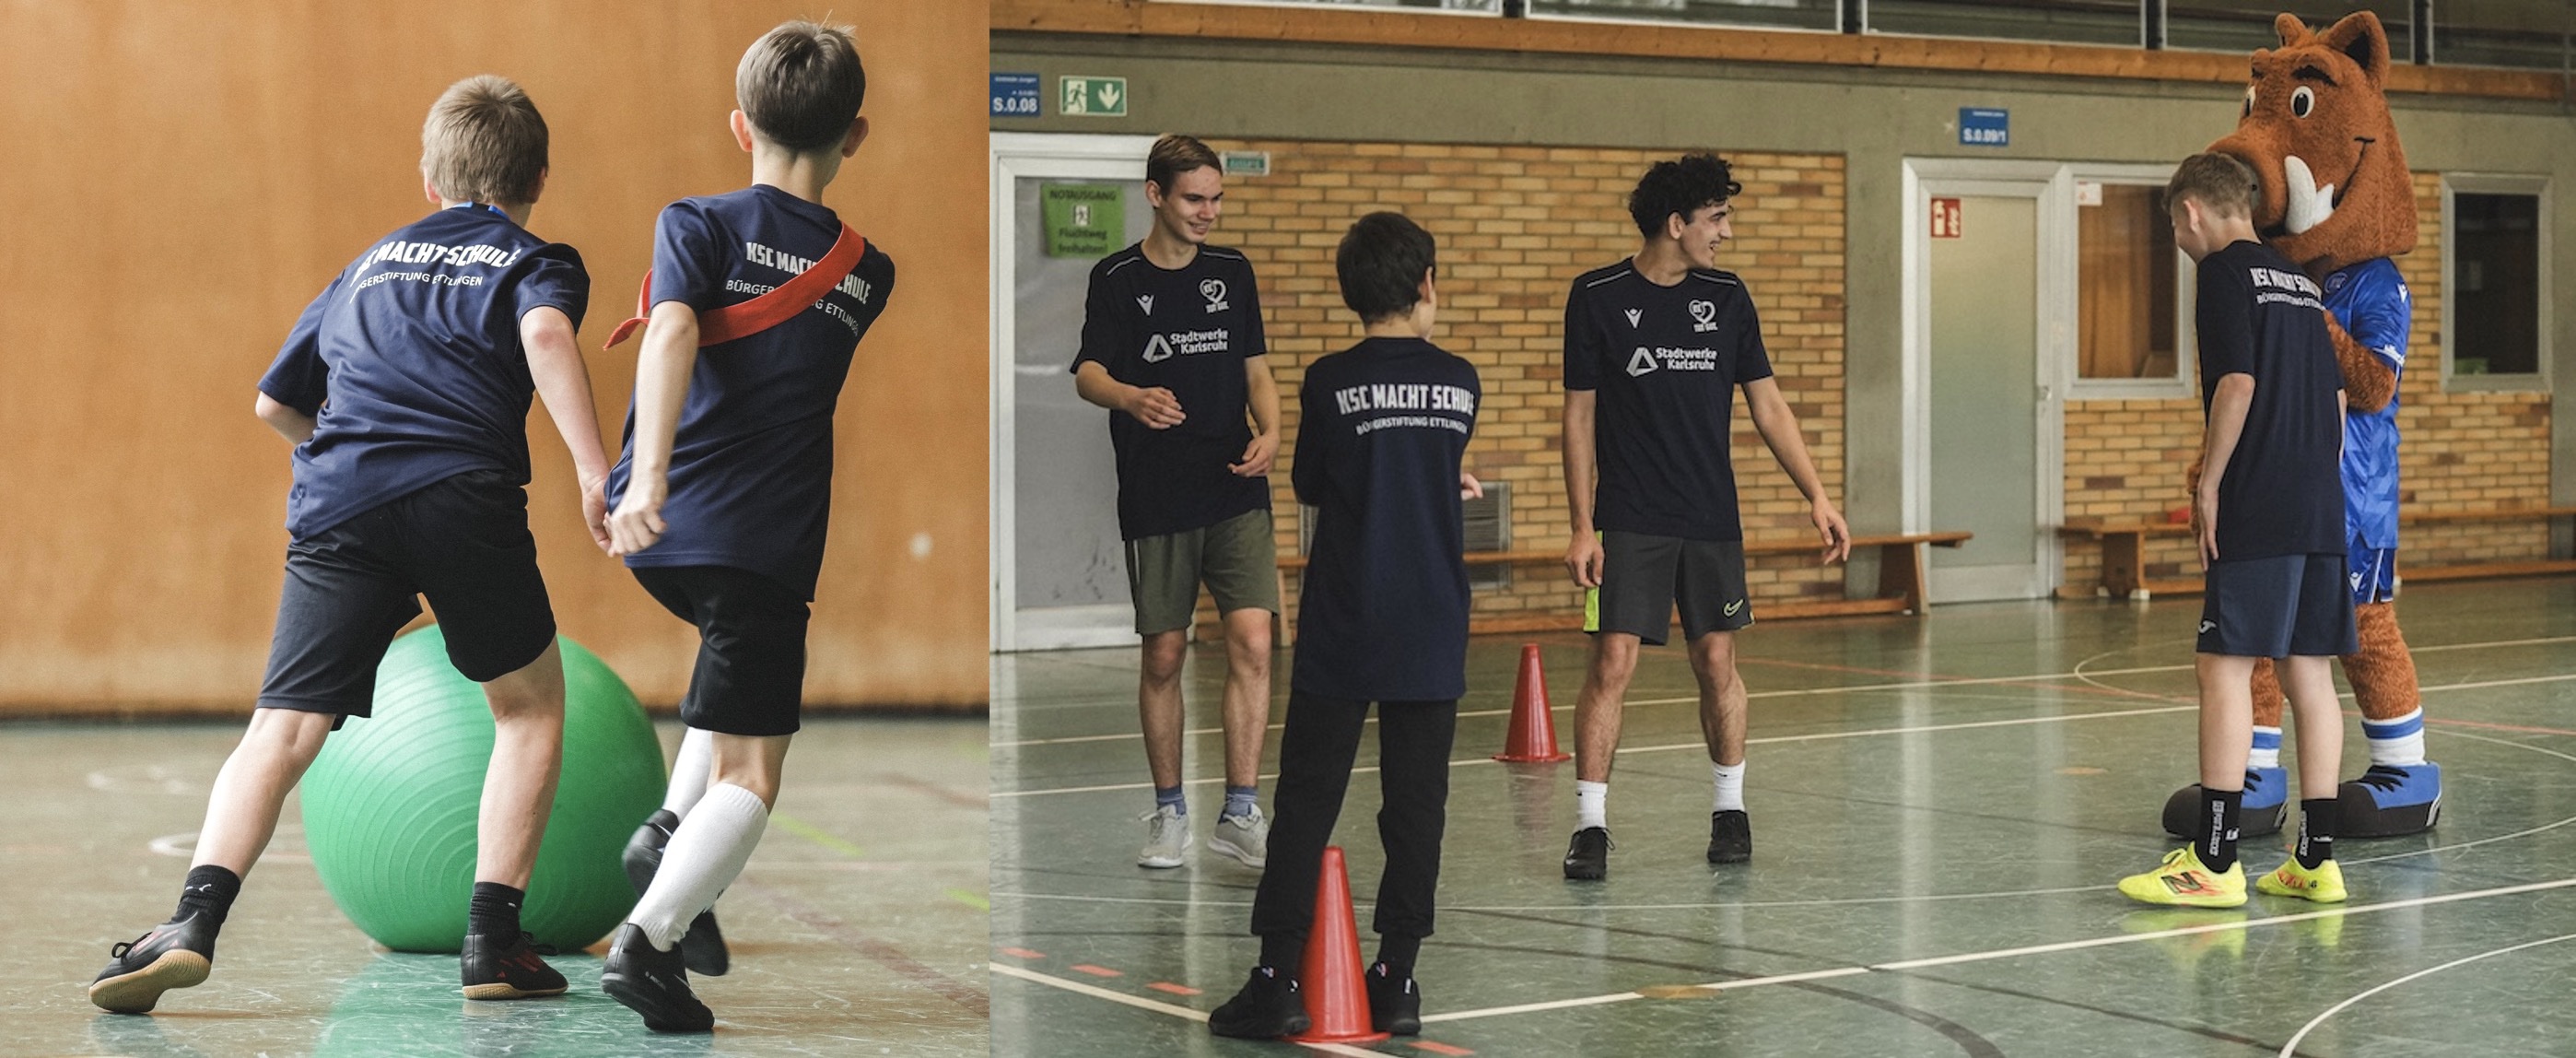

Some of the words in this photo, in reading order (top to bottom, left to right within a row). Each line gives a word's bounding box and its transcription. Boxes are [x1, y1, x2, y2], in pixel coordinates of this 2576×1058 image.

[993, 97, 1037, 112] S.0.08
[373, 241, 448, 264] MACHT
[444, 244, 521, 268] SCHULE
[746, 242, 775, 267] KSC
[1656, 347, 1717, 359] Stadtwerke
[1668, 358, 1715, 370] Karlsruhe
[1336, 385, 1371, 415] KSC
[1371, 383, 1429, 409] MACHT
